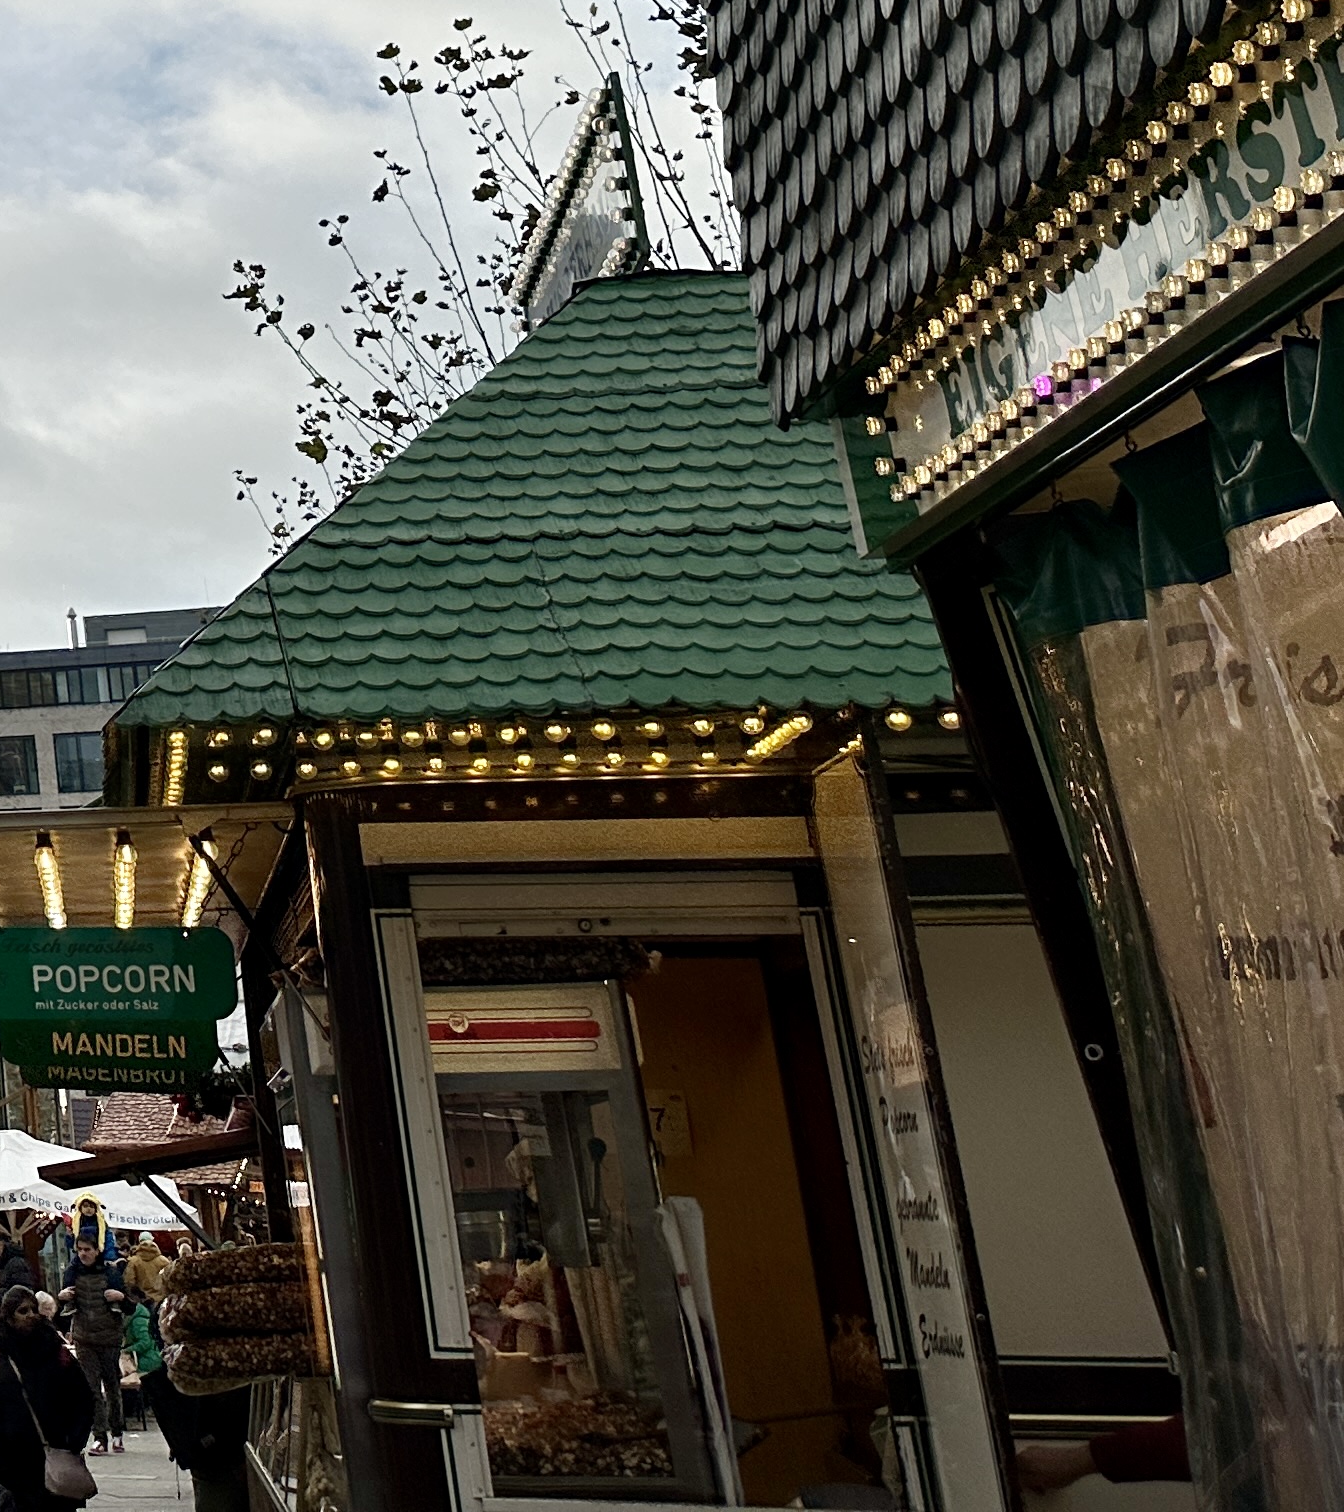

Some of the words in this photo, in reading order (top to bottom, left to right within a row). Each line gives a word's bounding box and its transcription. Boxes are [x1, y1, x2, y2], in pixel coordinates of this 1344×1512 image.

[936, 238, 1115, 438] EIGENE
[32, 964, 196, 994] POPCORN
[35, 1000, 54, 1011] mit
[57, 999, 99, 1011] Zucker
[102, 999, 130, 1011] oder
[133, 999, 160, 1011] Salz
[51, 1031, 187, 1060] MANDELN
[8, 1193, 18, 1204] &
[20, 1191, 51, 1207] Chips
